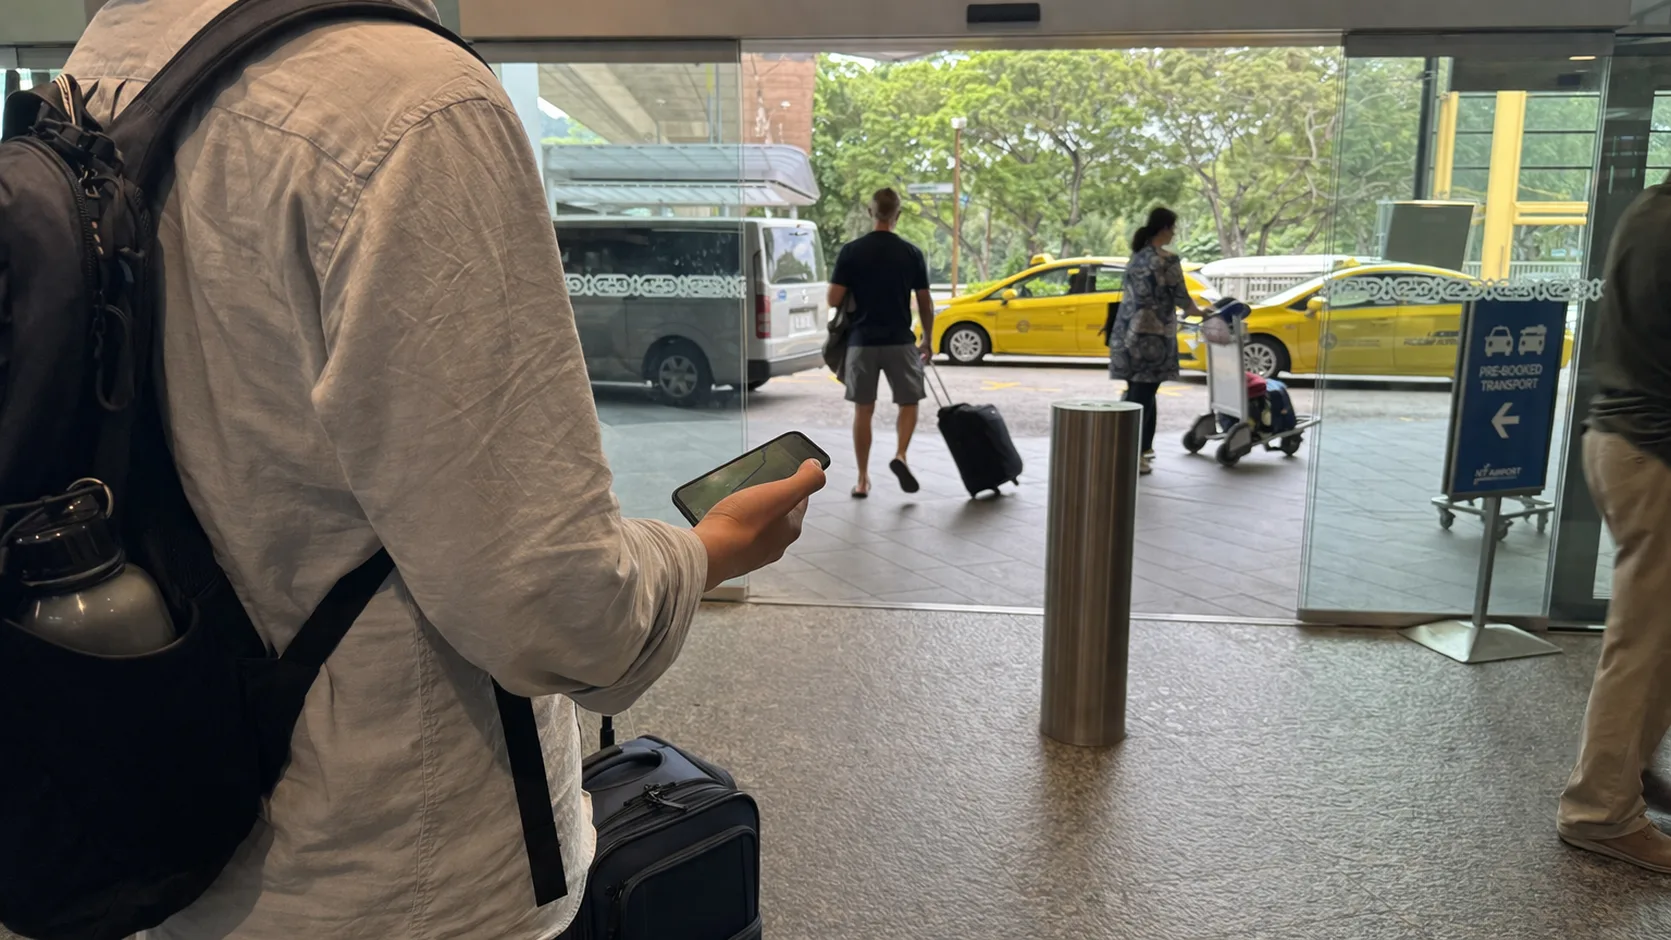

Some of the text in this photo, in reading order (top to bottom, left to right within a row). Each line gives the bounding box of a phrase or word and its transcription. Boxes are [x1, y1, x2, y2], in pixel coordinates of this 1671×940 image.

[1479, 364, 1543, 377] PRE-BOOKED
[1481, 378, 1538, 392] TRANSPORT
[1489, 467, 1522, 476] AIRPORT
